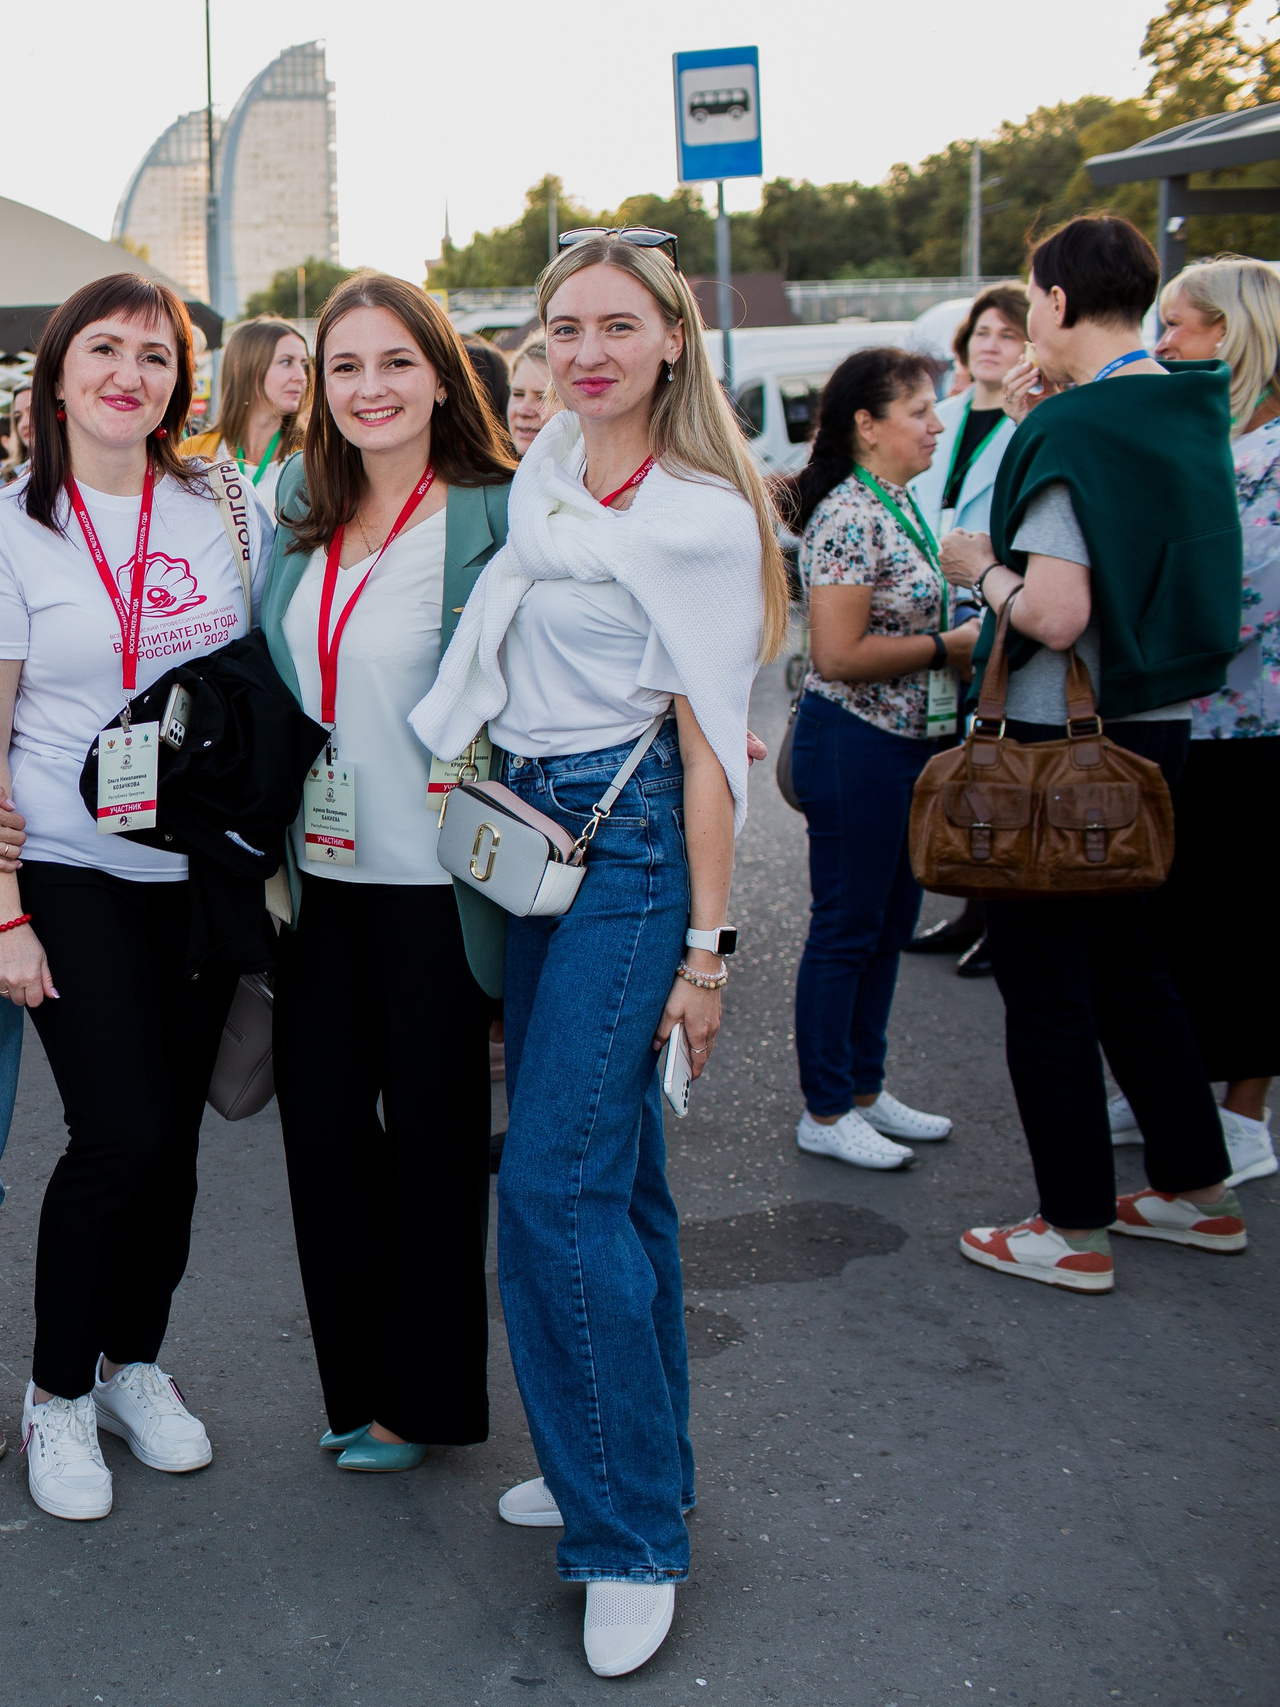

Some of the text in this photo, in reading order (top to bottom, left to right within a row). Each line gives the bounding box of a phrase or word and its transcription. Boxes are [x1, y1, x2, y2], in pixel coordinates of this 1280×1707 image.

[220, 462, 251, 562] ВОЛГОГР
[79, 510, 104, 564] ВОСПИТАТЕЛЬ ГОДА
[137, 512, 149, 563] ВОСПИТАТЕЛЬ ГОДА
[112, 613, 239, 654] ВСПИТАТЕЛЬ ГОДА
[128, 612, 139, 655] ВОСПИТАТЕЛЬ
[159, 607, 220, 631] ПРОФЕССИОНАЛЬНЫЙ
[137, 639, 192, 662] РОССИИ
[203, 630, 229, 647] 2023
[110, 802, 142, 815] УЧАСТНИК
[316, 835, 345, 847] УЧАСТНИК
